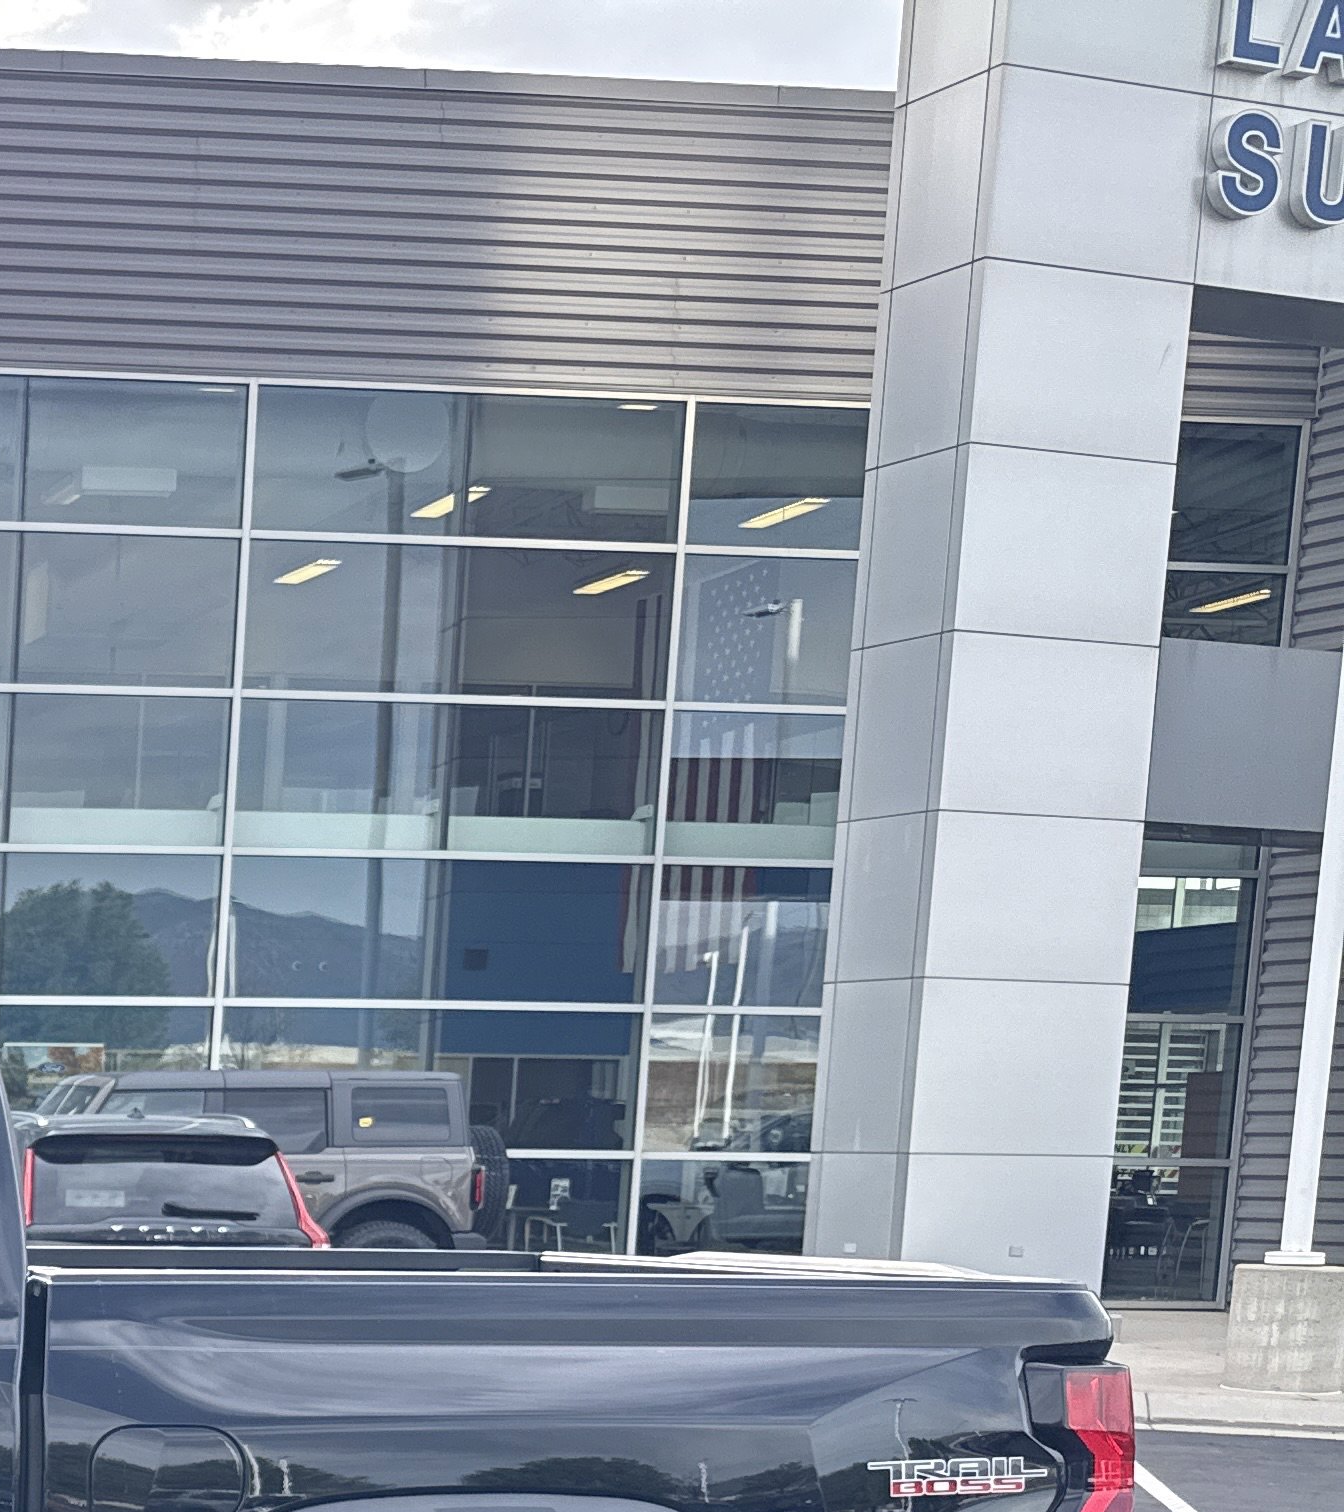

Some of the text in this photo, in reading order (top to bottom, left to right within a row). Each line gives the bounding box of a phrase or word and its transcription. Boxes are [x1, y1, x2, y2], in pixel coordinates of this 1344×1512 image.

[1217, 110, 1344, 224] SU
[866, 1456, 1048, 1479] TRAIL
[889, 1476, 1026, 1498] BOSS
